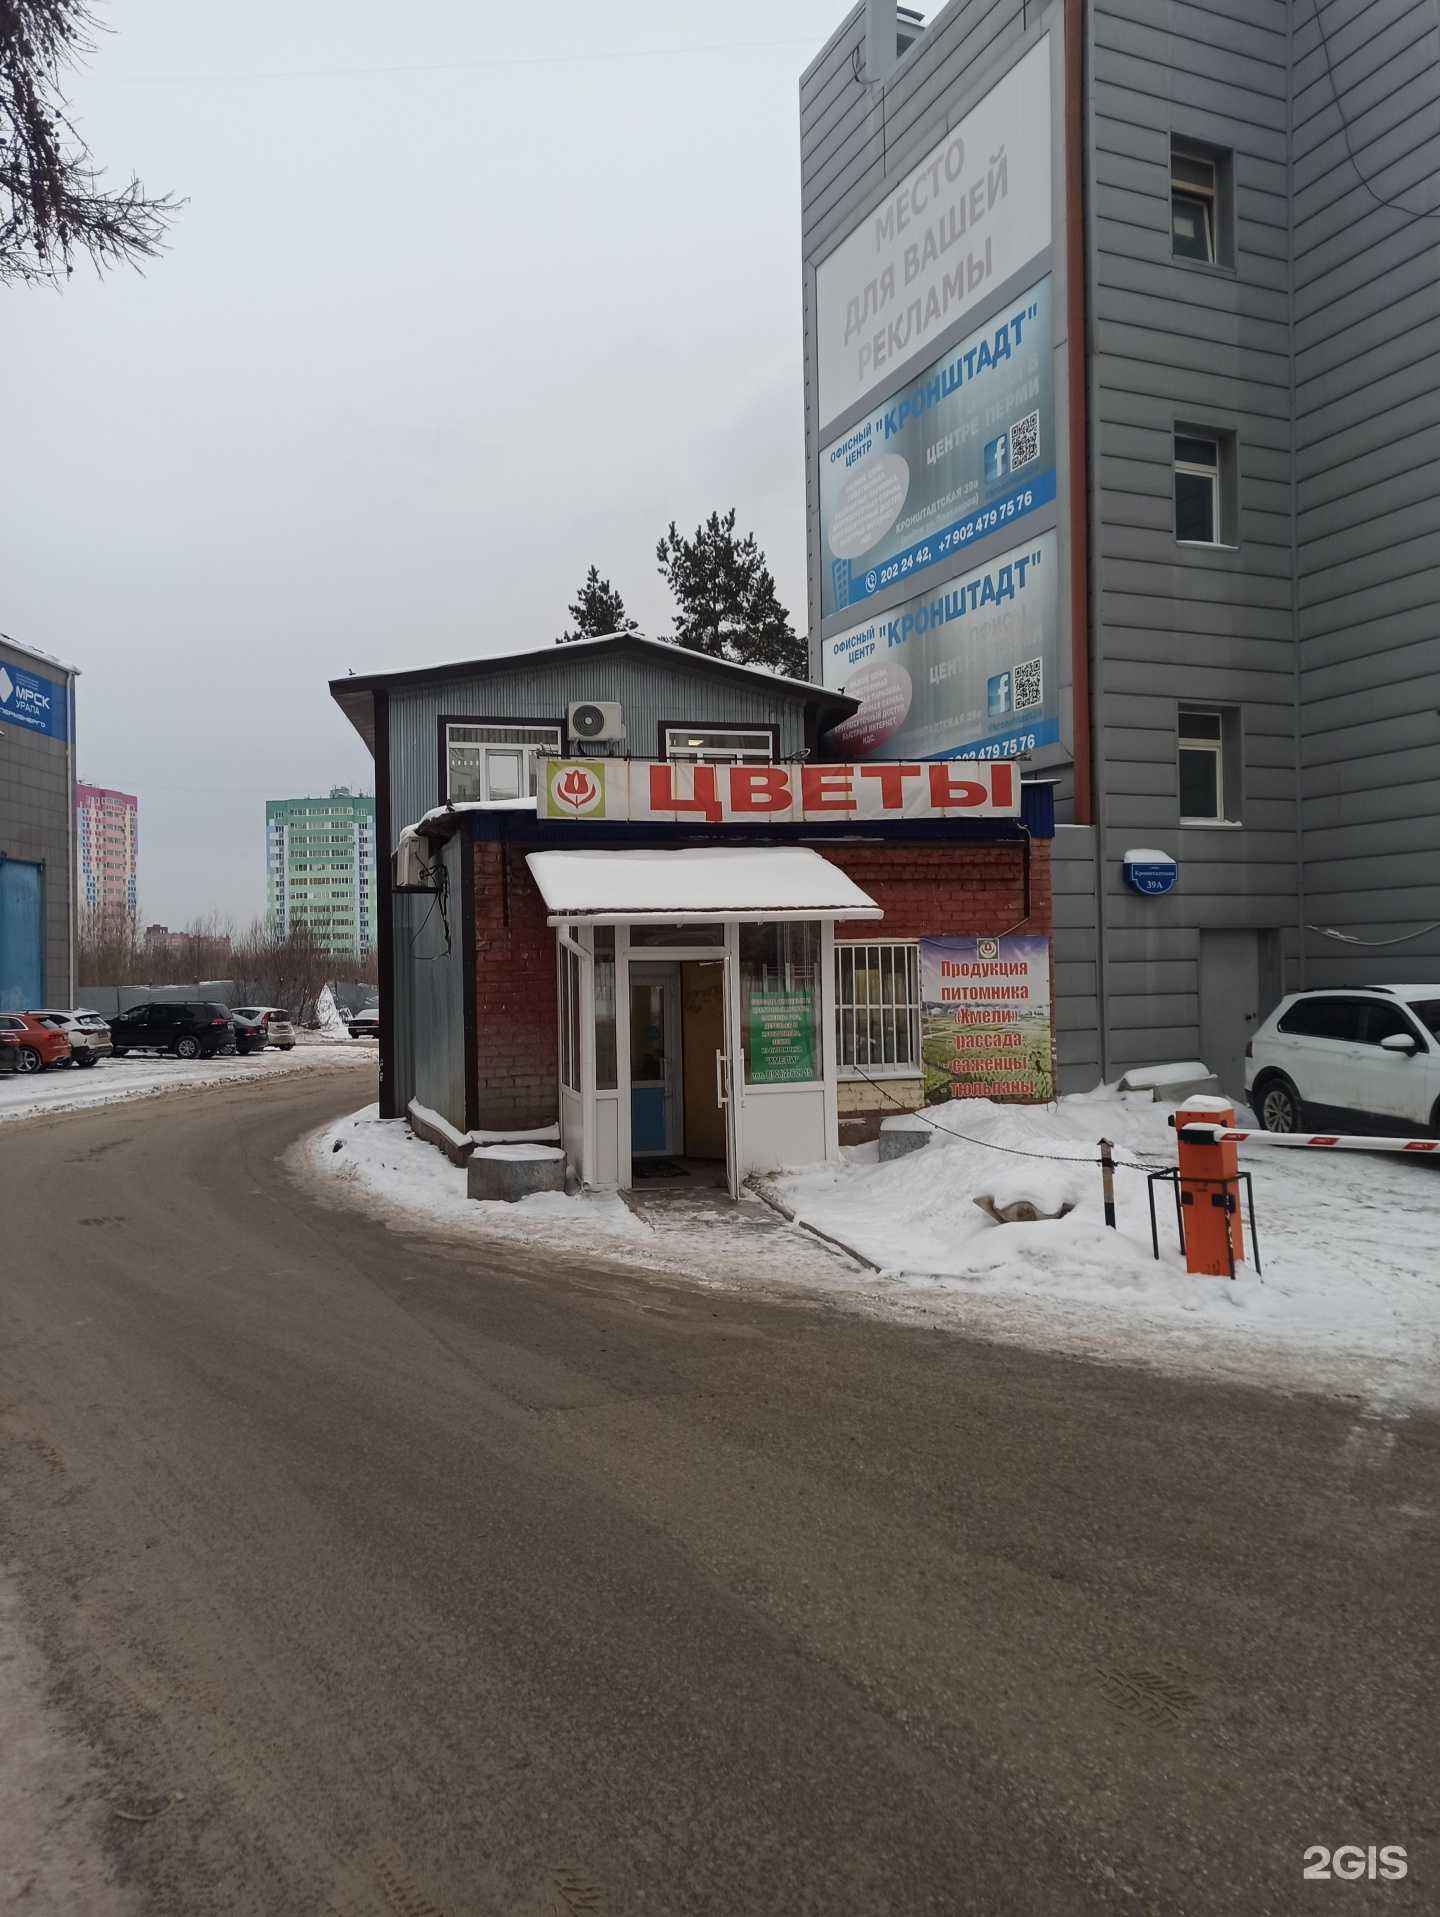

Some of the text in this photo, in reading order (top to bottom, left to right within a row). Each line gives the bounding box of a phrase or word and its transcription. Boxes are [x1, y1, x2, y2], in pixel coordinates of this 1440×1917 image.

[873, 136, 966, 252] МЕСТО
[844, 261, 896, 347] ДЛЯ
[904, 144, 1009, 288] ВАШЕЙ
[857, 236, 993, 381] РЕКЛАМЫ
[875, 302, 1038, 440] "КРОНШТАДТ"
[830, 421, 872, 463] ОФИСНЫЙ
[845, 440, 872, 467] ЦЕНТР
[880, 562, 899, 583] 202
[900, 555, 913, 570] 24
[938, 533, 950, 551] +7
[952, 523, 974, 545] 902
[975, 511, 997, 532] 479
[1000, 499, 1014, 520] 75
[1016, 490, 1032, 511] 76
[879, 550, 1041, 648] "КРОНШТАДТ"
[833, 625, 875, 656] ОФИСНЫЙ
[848, 643, 875, 664] ЦЕНТР
[16, 686, 50, 710] МРСК
[16, 700, 40, 715] УРАЛА
[1003, 738, 1018, 756] 75
[1019, 734, 1035, 751] 76
[649, 763, 1013, 821] ЦВЕТЫ
[941, 960, 1028, 978] Продукция
[941, 985, 1029, 1001] питомника
[952, 1057, 1027, 1073] саженцы
[951, 1081, 1034, 1097] тюльпаны
